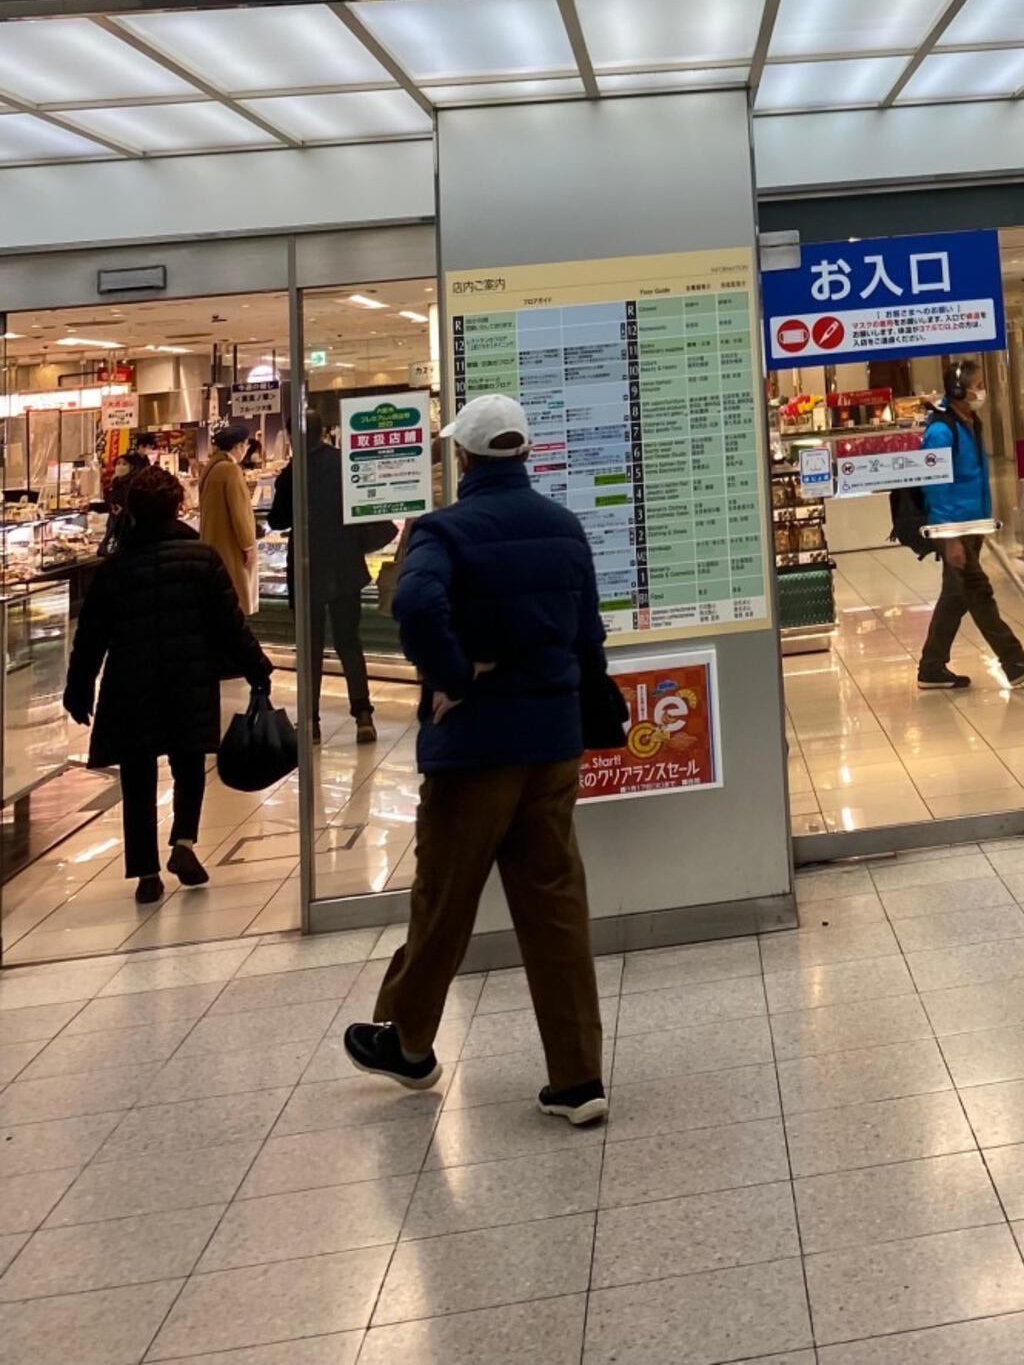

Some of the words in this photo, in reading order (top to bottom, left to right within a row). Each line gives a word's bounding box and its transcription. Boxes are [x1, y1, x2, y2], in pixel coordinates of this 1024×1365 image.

[810, 251, 950, 301] お入口
[452, 278, 506, 294] 店内ご案内
[357, 431, 417, 447] 取扱店舗
